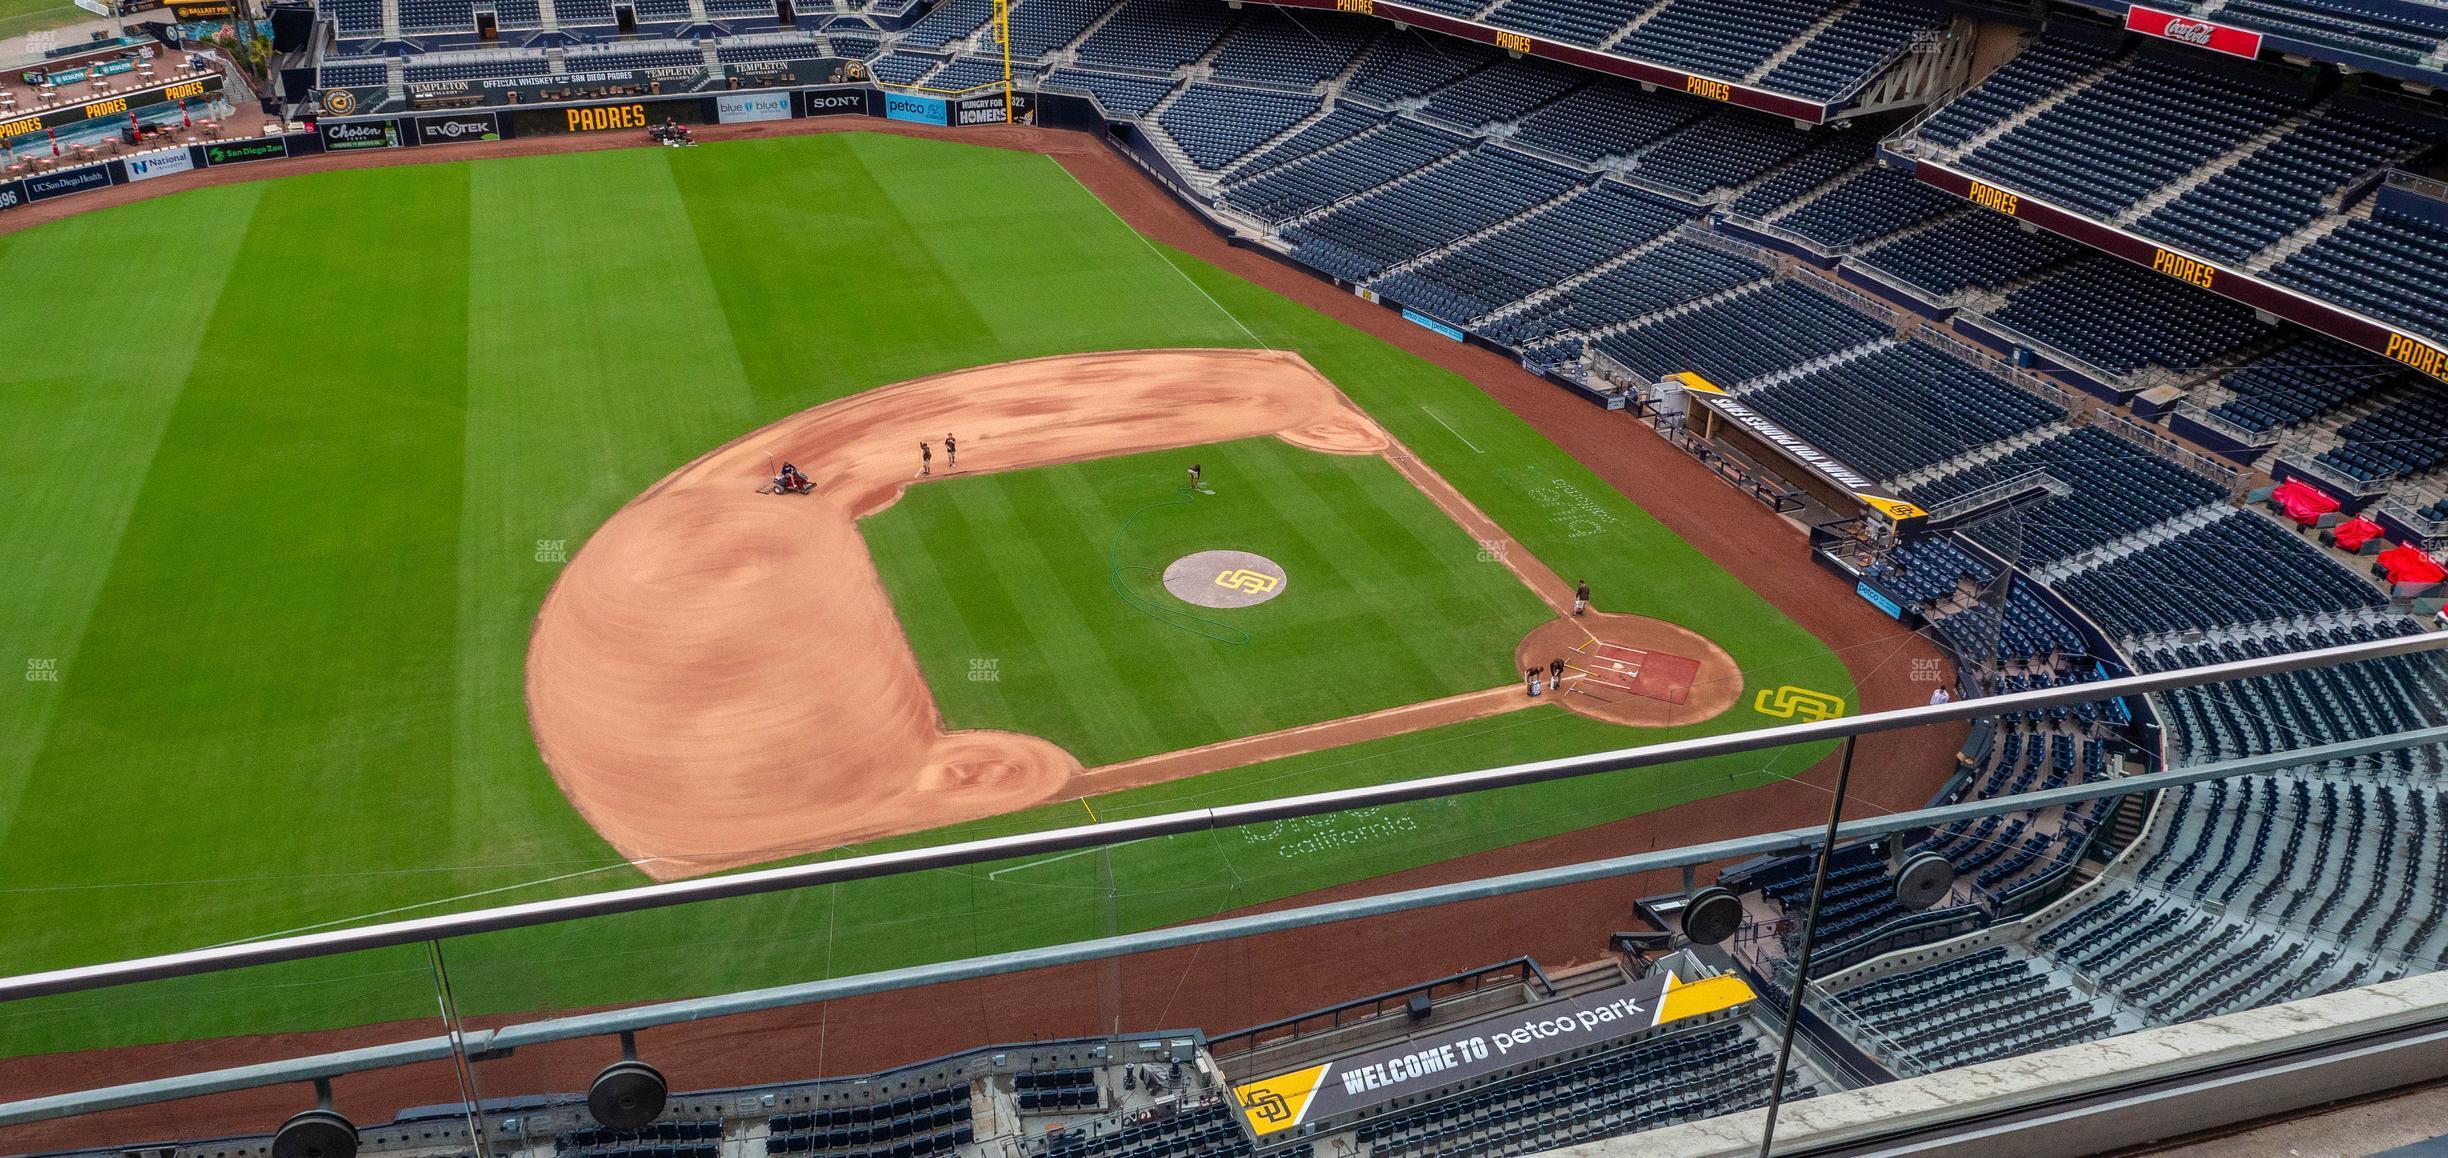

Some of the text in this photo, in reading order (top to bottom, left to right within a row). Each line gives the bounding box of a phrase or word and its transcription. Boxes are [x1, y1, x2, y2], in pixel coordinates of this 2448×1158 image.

[1337, 0, 1373, 15] PADRES
[1496, 31, 1531, 53] PADRES
[645, 66, 700, 79] TEMPLETON
[734, 61, 788, 73] TEMPLETON
[408, 80, 470, 94] TEMPLETON
[483, 77, 518, 89] OFFICIAL
[519, 75, 554, 87] WHISKEY
[571, 74, 585, 83] SAN
[586, 72, 606, 82] DIEGO
[607, 71, 633, 81] PADRES
[165, 81, 204, 101] PADRES
[1687, 76, 1730, 101] PADRES
[85, 98, 128, 119] PADRES
[720, 103, 743, 113] blue
[755, 100, 778, 110] blue
[814, 96, 860, 109] SONY
[889, 99, 924, 113] petco
[961, 98, 1003, 109] HUNGRY FOR
[1011, 96, 1025, 108] 322
[566, 104, 646, 132] PADRES
[959, 108, 1007, 124] HOMERS
[0, 117, 42, 139] PADRES
[329, 124, 381, 139] Chosen
[426, 121, 490, 137] EVOTEK
[226, 144, 283, 158] San Diego Zoo
[149, 153, 187, 167] National
[33, 172, 103, 193] UC San Diego Health
[1969, 181, 2017, 215] PADRES
[2153, 248, 2215, 288] PADRES
[1711, 398, 1872, 489] THANK YOU PADRES FANS
[1858, 584, 1879, 601] petco
[1280, 816, 1417, 858] california
[1341, 997, 1645, 1096] WELCOME TO petco park
